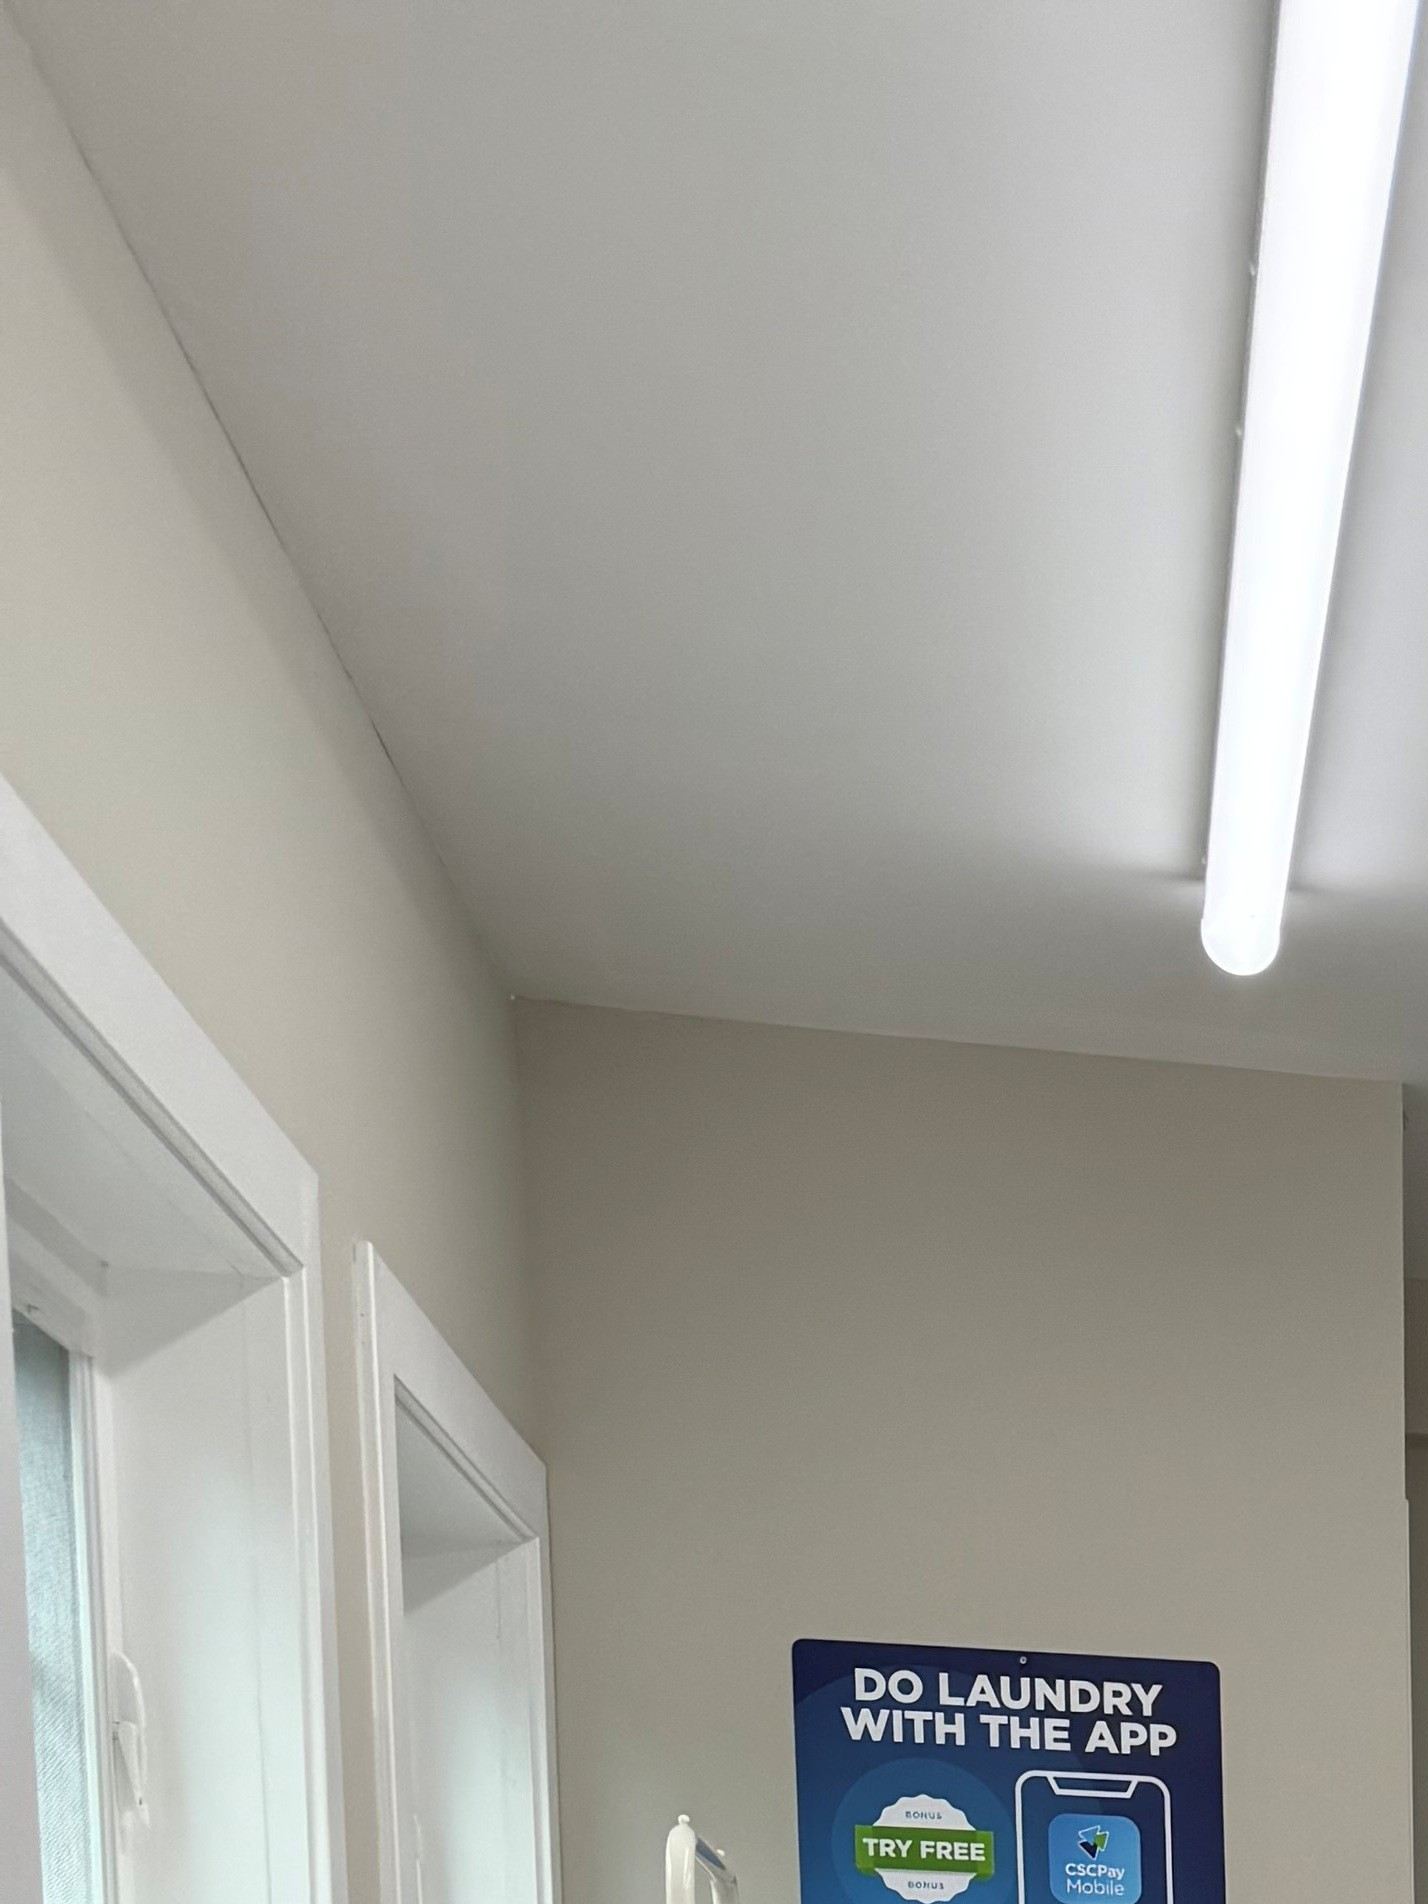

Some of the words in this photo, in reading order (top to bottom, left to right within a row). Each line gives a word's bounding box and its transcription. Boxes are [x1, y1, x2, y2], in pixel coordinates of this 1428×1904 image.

[854, 1667, 923, 1704] DO
[938, 1672, 1163, 1717] LAUNDRY
[840, 1706, 965, 1746] WITH
[979, 1714, 1072, 1751] THE
[1084, 1720, 1177, 1756] APP
[905, 1810, 943, 1820] BONUS
[862, 1838, 912, 1858] TRY
[920, 1840, 986, 1861] FREE
[1065, 1863, 1125, 1880] CSCPay
[907, 1880, 944, 1890] BONUS
[1066, 1878, 1125, 1896] Mobile
